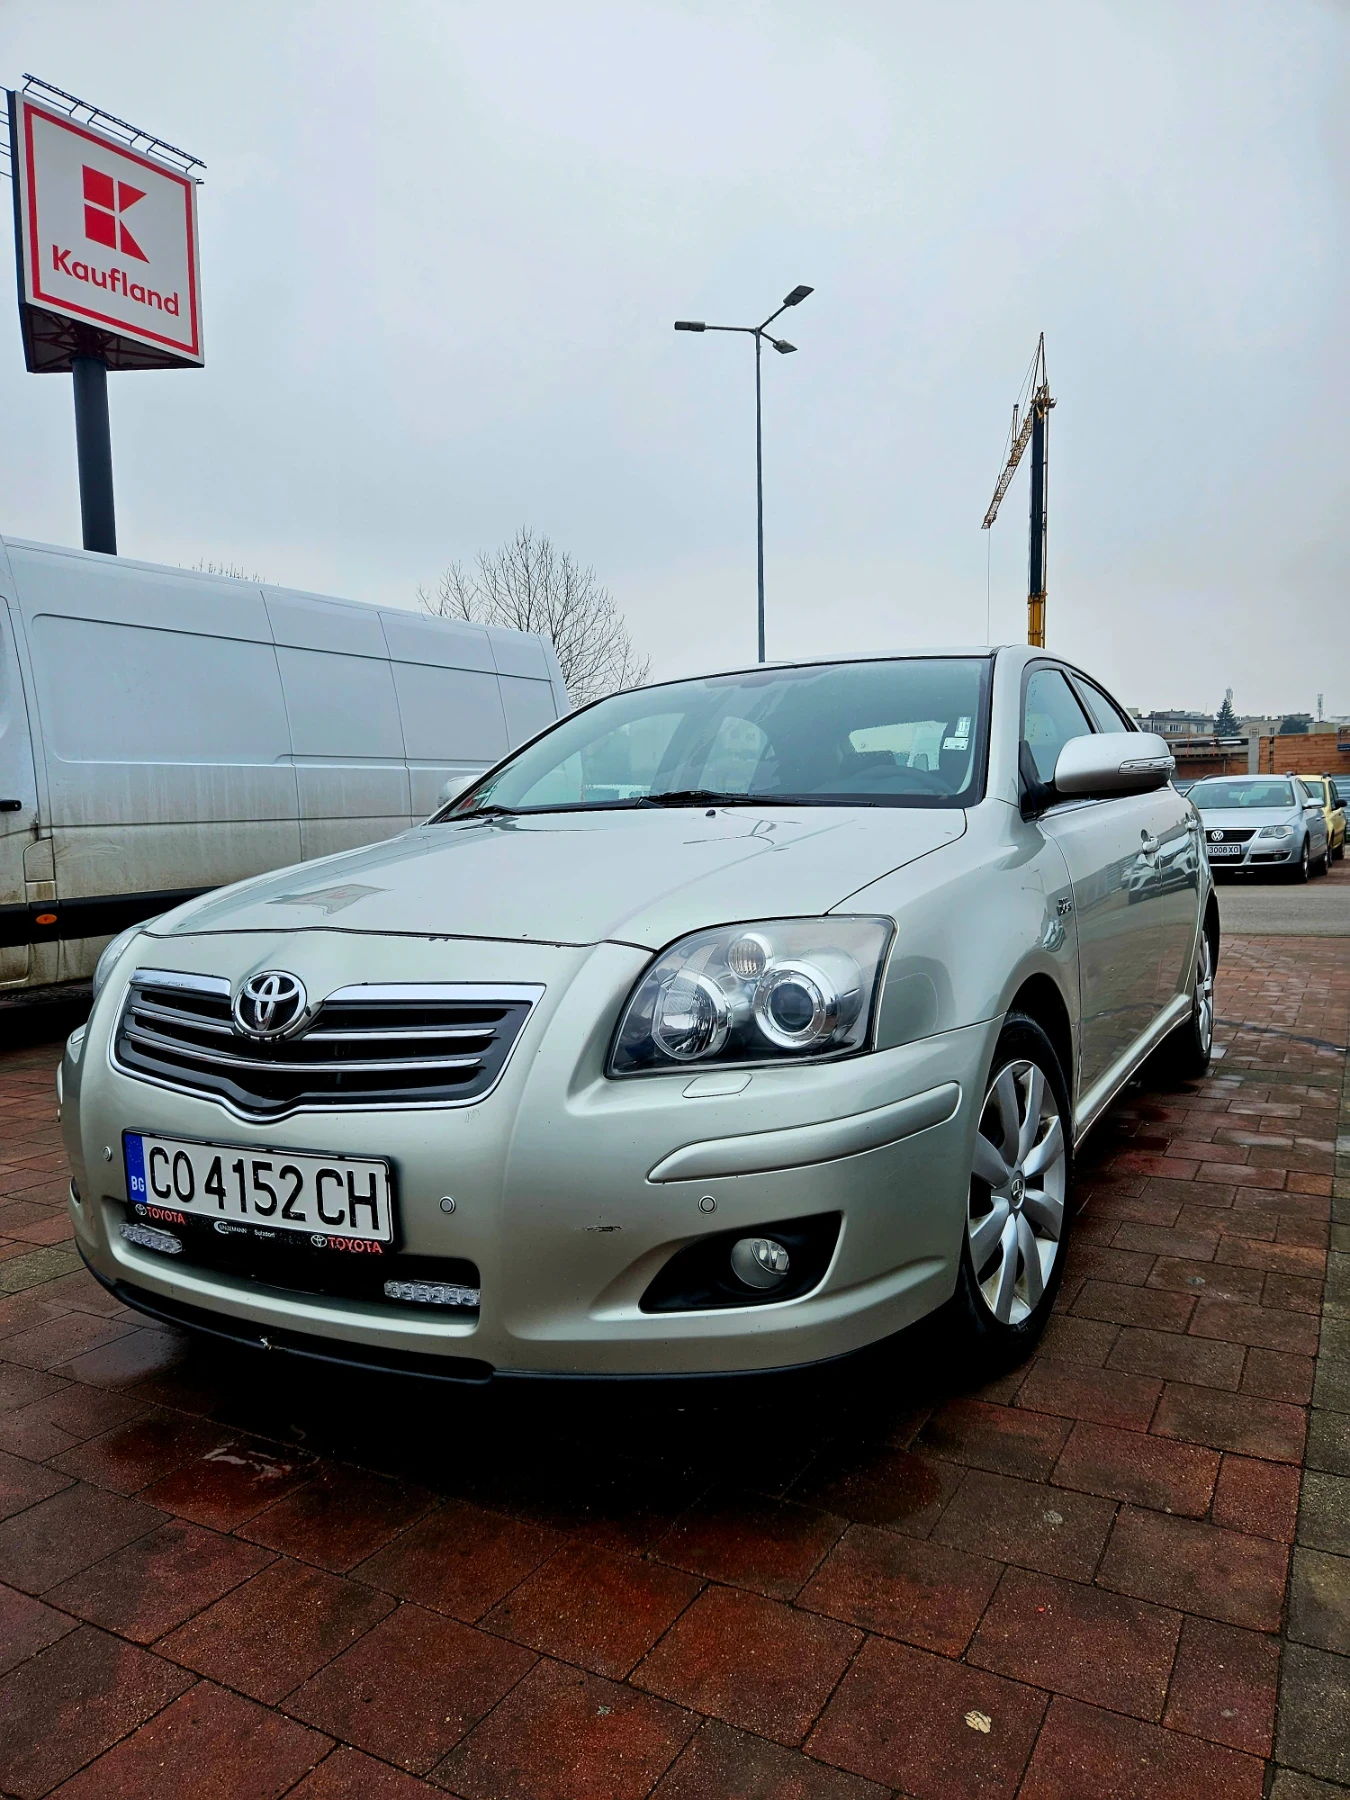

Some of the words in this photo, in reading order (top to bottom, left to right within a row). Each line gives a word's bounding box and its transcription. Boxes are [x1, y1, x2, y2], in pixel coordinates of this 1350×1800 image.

[52, 244, 179, 317] Kaufland
[131, 1175, 145, 1193] BG
[149, 1146, 195, 1203] CO
[204, 1155, 306, 1222] 4152
[316, 1168, 380, 1231] CH
[146, 1206, 186, 1224] TOYOTA
[328, 1236, 383, 1254] TOYOTA
